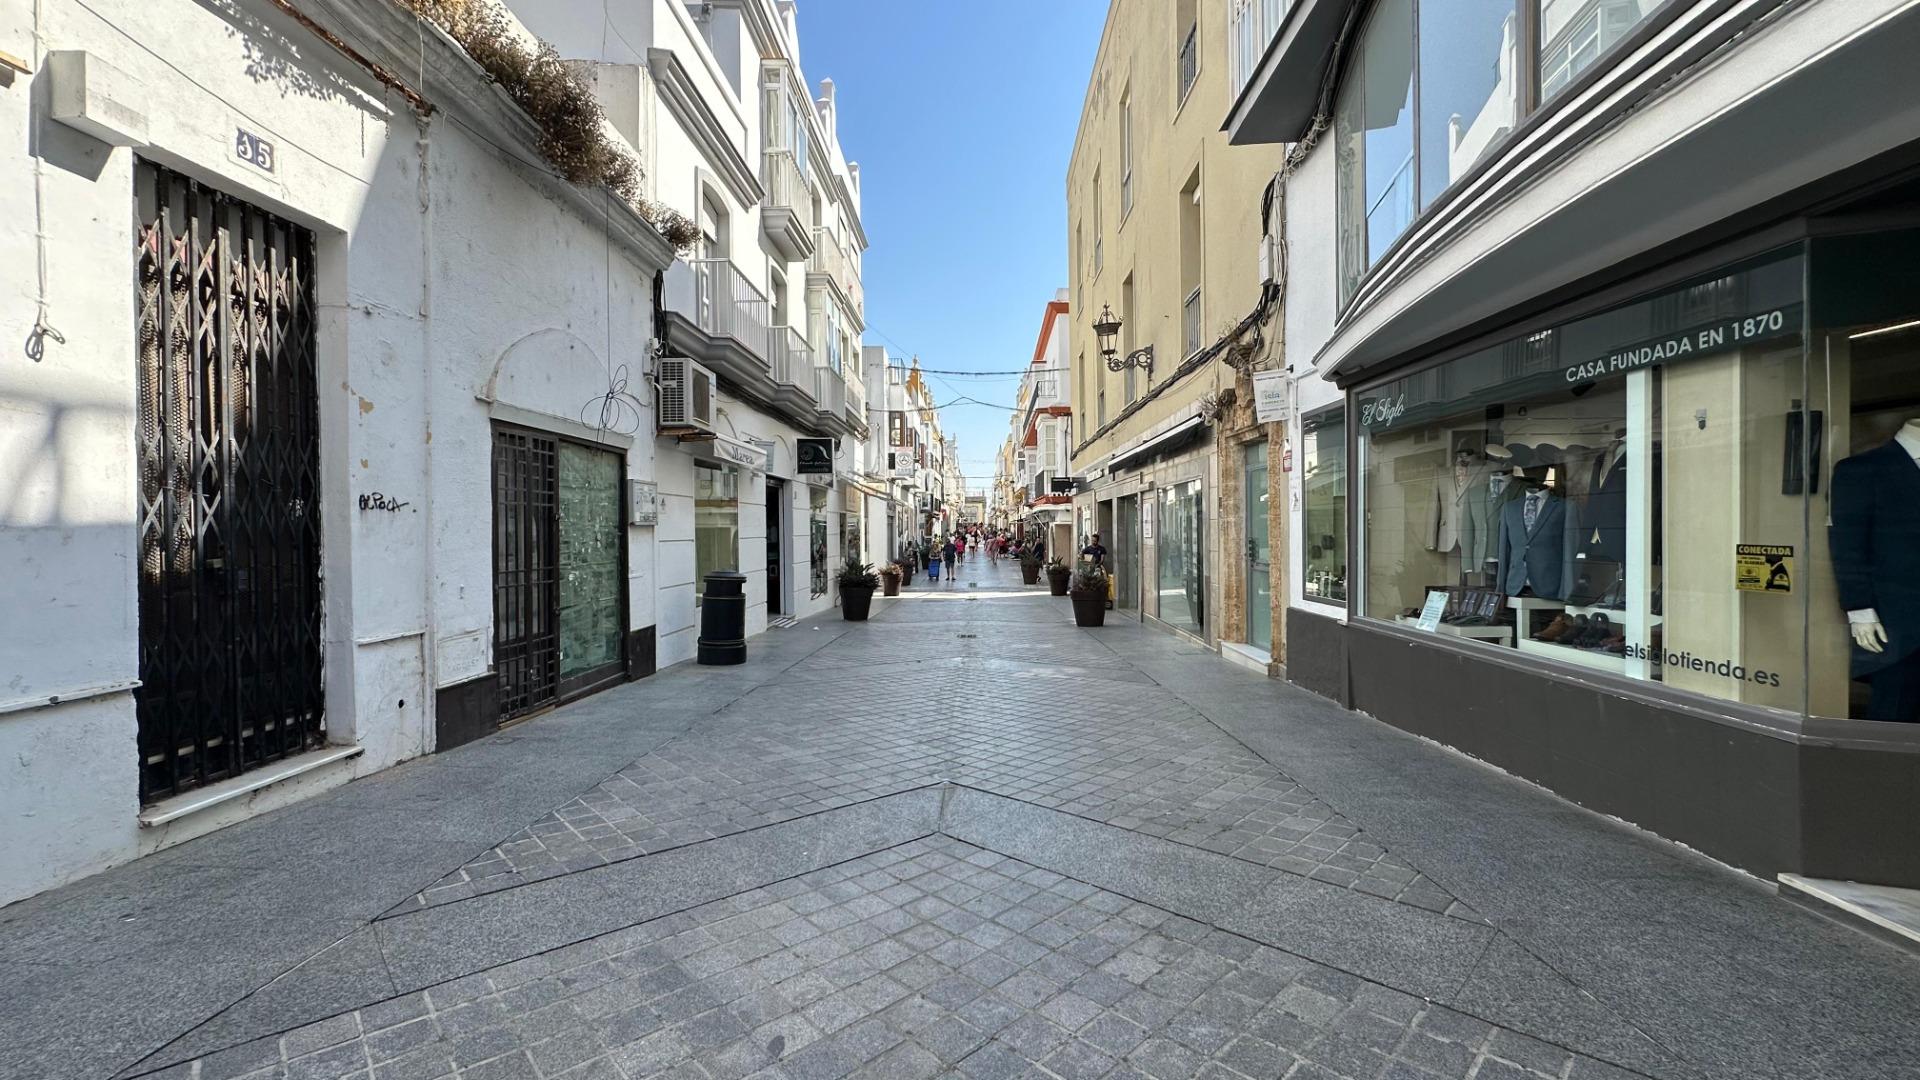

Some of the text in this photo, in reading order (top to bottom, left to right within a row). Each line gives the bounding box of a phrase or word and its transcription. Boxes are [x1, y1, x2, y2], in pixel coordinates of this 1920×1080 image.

[238, 133, 270, 169] 35
[1566, 311, 1783, 382] CASA FUNDADA EN 1870
[1362, 393, 1404, 426] El Siglo
[1738, 545, 1791, 555] CONECTADA
[1625, 642, 1780, 687] elsiglotienda.es
